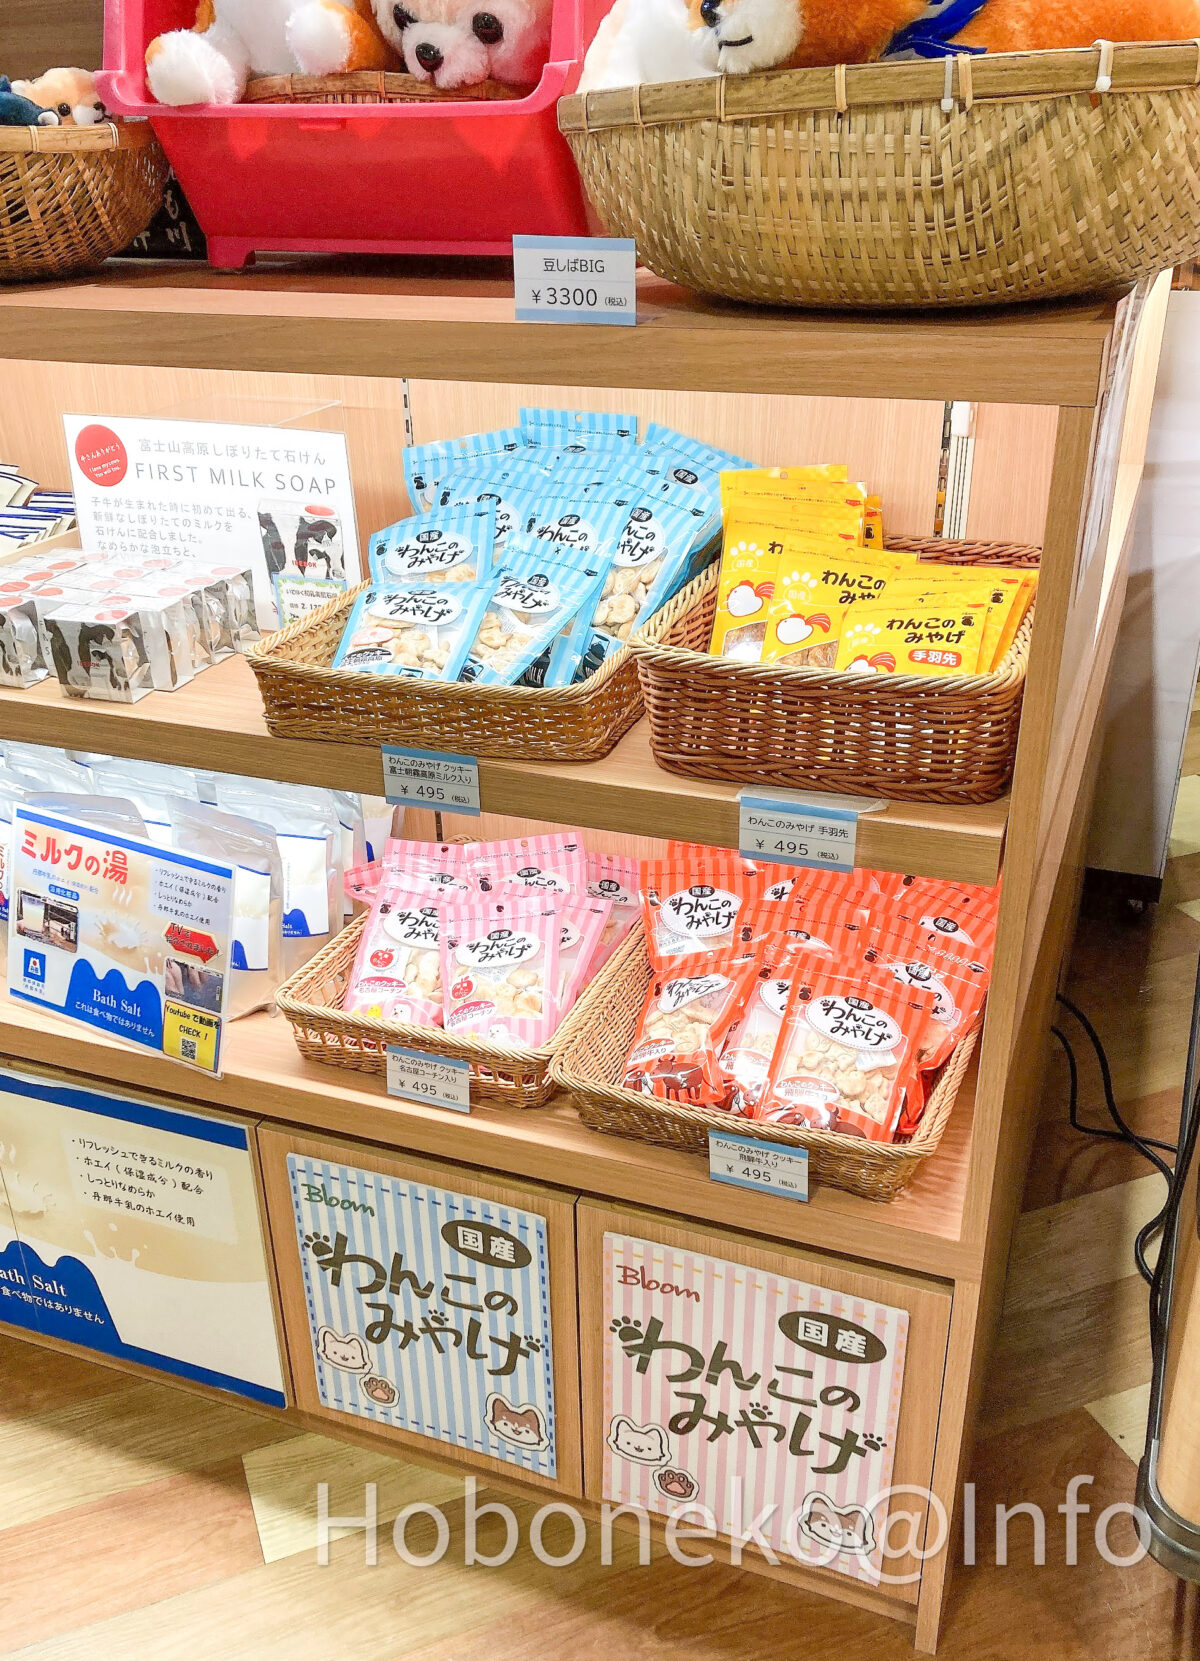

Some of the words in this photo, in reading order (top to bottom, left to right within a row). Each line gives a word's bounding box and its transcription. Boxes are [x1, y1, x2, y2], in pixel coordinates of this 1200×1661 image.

[543, 258, 605, 273] 豆しばBIG
[138, 438, 326, 466] 富士山高原しぼりたて石けん
[135, 462, 198, 484] FIRST
[209, 467, 265, 490] MILK
[275, 473, 336, 496] SOAP
[675, 470, 698, 484] 国産
[96, 526, 203, 545] 石けんに配合しました。
[624, 520, 656, 541] んこの
[397, 542, 459, 559] わんこの
[407, 550, 464, 569] みやげ
[617, 538, 654, 562] やげ
[821, 570, 886, 591] わんこの
[385, 594, 449, 606] わんこの
[839, 591, 882, 605] みや
[389, 604, 453, 622] みやげ
[886, 618, 956, 631] わんこの
[904, 630, 966, 644] みやげ
[911, 650, 957, 666] 手羽先
[388, 756, 441, 771] わんこのみやげ
[443, 763, 472, 774] クッキー
[389, 766, 472, 784] 富士朝霧高原ミルク入り
[401, 784, 408, 795] ¥
[416, 785, 445, 800] 495
[748, 816, 816, 833] わんこのみやげ
[818, 826, 849, 839] 手羽先
[21, 829, 129, 885] ミルクの湯
[756, 839, 765, 849] ¥
[774, 840, 809, 856] 495
[672, 896, 732, 916] わんこの
[686, 911, 738, 930] みやげ
[470, 937, 527, 954] わんこの
[478, 944, 533, 963] みやげ
[93, 988, 117, 1009] Bath
[120, 998, 142, 1018] Salt
[75, 1001, 156, 1038] これは食べ物ではありません
[821, 1000, 888, 1029] わんこの
[830, 1020, 893, 1046] みやげ
[391, 1054, 437, 1070] わんこのみやげ
[440, 1065, 465, 1075] クッキー
[399, 1064, 457, 1084] 名古屋コーチン入り
[412, 1081, 437, 1096] 495
[78, 1137, 213, 1181] リフレッシュできるミルクの香り
[716, 1140, 770, 1158] わんこのみやげ
[772, 1153, 802, 1164] クッキー
[739, 1153, 778, 1168] 飛騨牛入り
[742, 1167, 771, 1182] 495
[87, 1172, 156, 1199] しっとりなめらか
[302, 1183, 375, 1217] Bloom
[457, 1225, 516, 1263] 国産
[317, 1231, 519, 1317] わんこの
[616, 1264, 700, 1302] Bloom
[32, 1274, 67, 1297] Salt
[0, 1286, 105, 1325] 食べ物ではありません
[365, 1302, 546, 1377] みやげ
[797, 1316, 867, 1358] 国産
[621, 1315, 862, 1413] わんこの
[668, 1391, 888, 1475] みやげ
